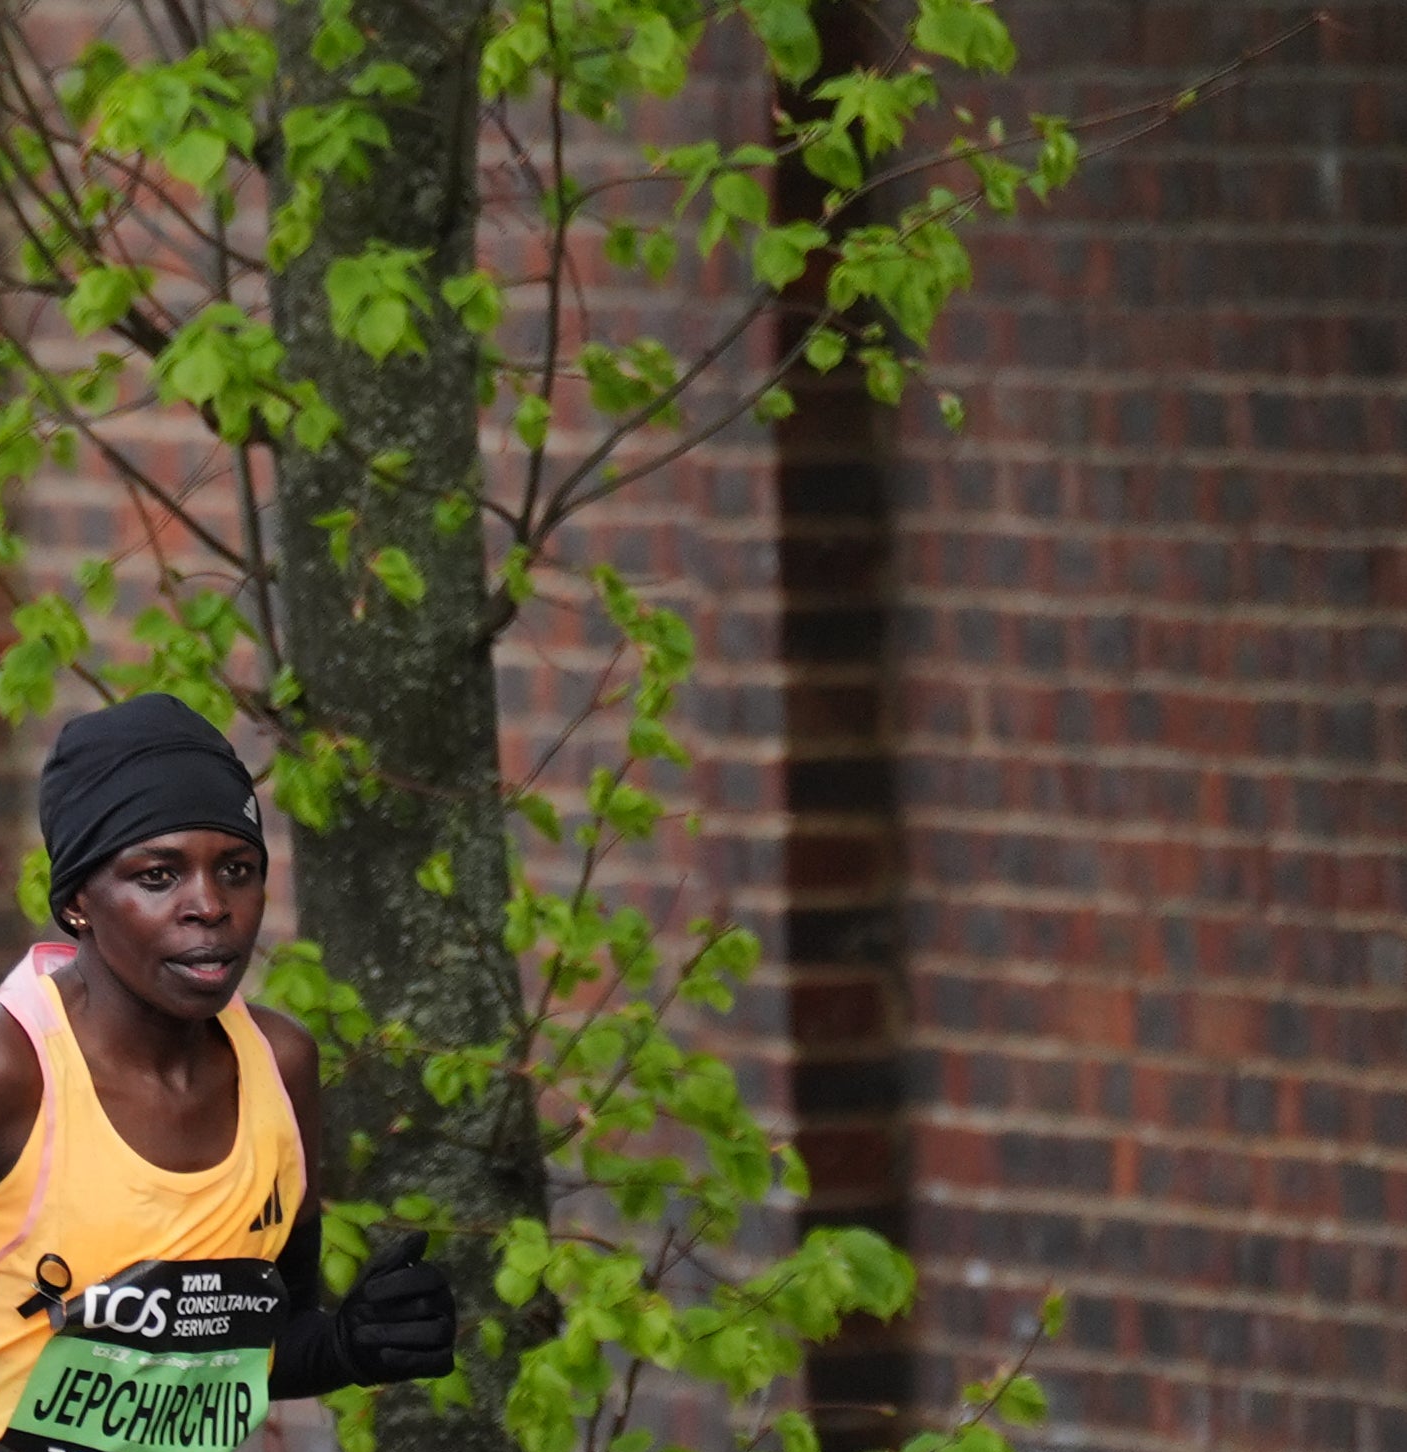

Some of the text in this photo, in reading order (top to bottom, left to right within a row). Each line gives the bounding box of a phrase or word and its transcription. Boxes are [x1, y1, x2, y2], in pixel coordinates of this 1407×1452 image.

[182, 1274, 222, 1292] TATA
[83, 1285, 171, 1338] tcs
[176, 1294, 279, 1315] CONSULTANCY
[171, 1316, 231, 1338] SERVICES
[34, 1367, 252, 1448] JEPCHIRCHIR
